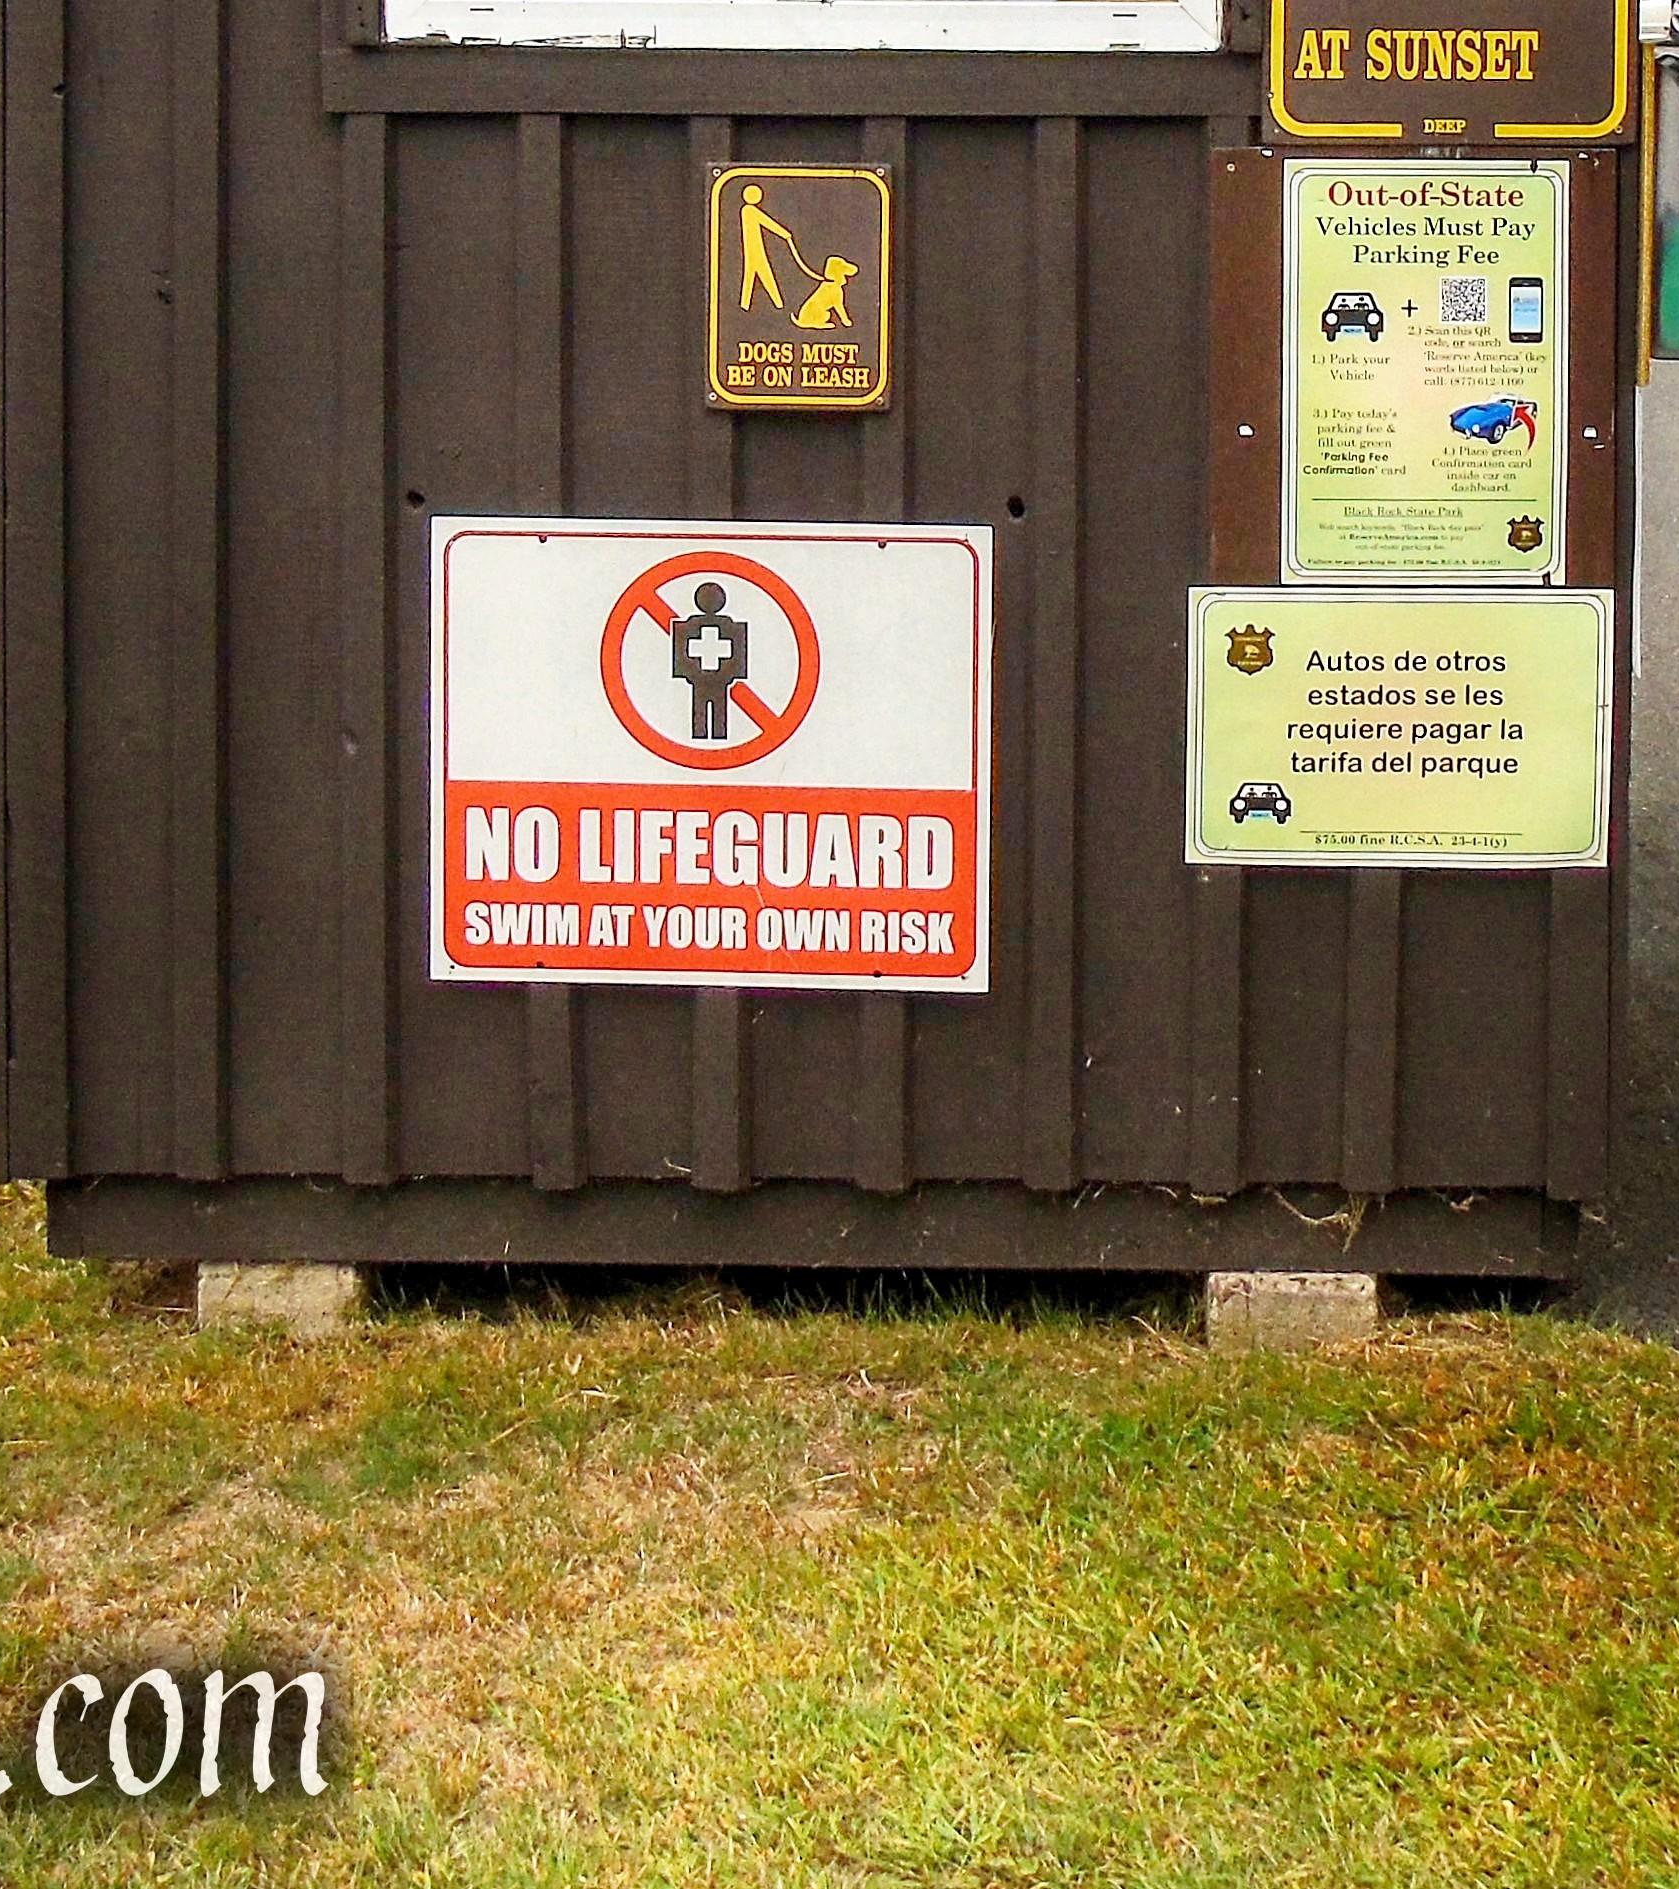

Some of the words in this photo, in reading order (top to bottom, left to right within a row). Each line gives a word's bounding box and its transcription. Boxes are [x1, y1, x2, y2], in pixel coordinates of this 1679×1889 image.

[1293, 29, 1350, 80] AT
[1366, 30, 1540, 81] SUNSET
[1423, 119, 1466, 135] DEEP
[1328, 179, 1524, 207] Out-of-State
[1315, 217, 1416, 237] Vehicles
[1423, 217, 1484, 237] Must
[1490, 218, 1536, 240] Pay
[1352, 245, 1450, 268] Parking
[1458, 245, 1500, 264] Fee
[1407, 326, 1421, 336] 2)
[1452, 325, 1472, 336] this
[1475, 326, 1491, 337] QR
[738, 342, 794, 363] DOGS
[801, 343, 859, 364] MUST
[1330, 353, 1359, 365] Park
[1363, 356, 1391, 367] your
[1330, 369, 1375, 381] Vehicle
[1458, 365, 1487, 373] listed
[727, 365, 756, 386] BE
[763, 366, 793, 387] ON
[801, 367, 870, 388] LEASH
[1424, 376, 1447, 386] call
[1332, 408, 1354, 420] Pay
[1317, 423, 1363, 435] parking
[1366, 424, 1383, 433] fee
[1386, 424, 1397, 433] &
[1318, 437, 1334, 447] fill
[1337, 438, 1356, 447] out
[1359, 440, 1393, 449] green
[1369, 452, 1389, 461] Fee
[1459, 446, 1489, 456] Place
[1491, 448, 1523, 457] green
[1431, 458, 1506, 468] Confirmation
[1508, 458, 1533, 468] card
[1381, 465, 1407, 475] card
[1482, 472, 1500, 480] car
[1406, 506, 1435, 517] State
[1438, 507, 1464, 518] Park
[1305, 650, 1386, 673] Autos
[1393, 650, 1429, 673] de
[1435, 652, 1507, 673] otros
[1307, 684, 1416, 707] estados
[1424, 689, 1456, 707] se
[1465, 684, 1504, 707] les
[1285, 719, 1403, 742] requiere
[1411, 722, 1492, 743] pagar
[1500, 718, 1524, 741] la
[1290, 751, 1363, 774] tarifa
[1372, 751, 1412, 774] del
[1420, 756, 1519, 779] parque
[1315, 834, 1356, 845] $75.00
[1360, 834, 1386, 845] fine
[464, 805, 561, 883] NO
[578, 808, 955, 891] LIFEGUARD
[464, 901, 580, 947] SWIM
[588, 904, 635, 948] AT
[642, 905, 748, 951] YOUR
[756, 907, 851, 953] OWN
[859, 911, 955, 956] RISK
